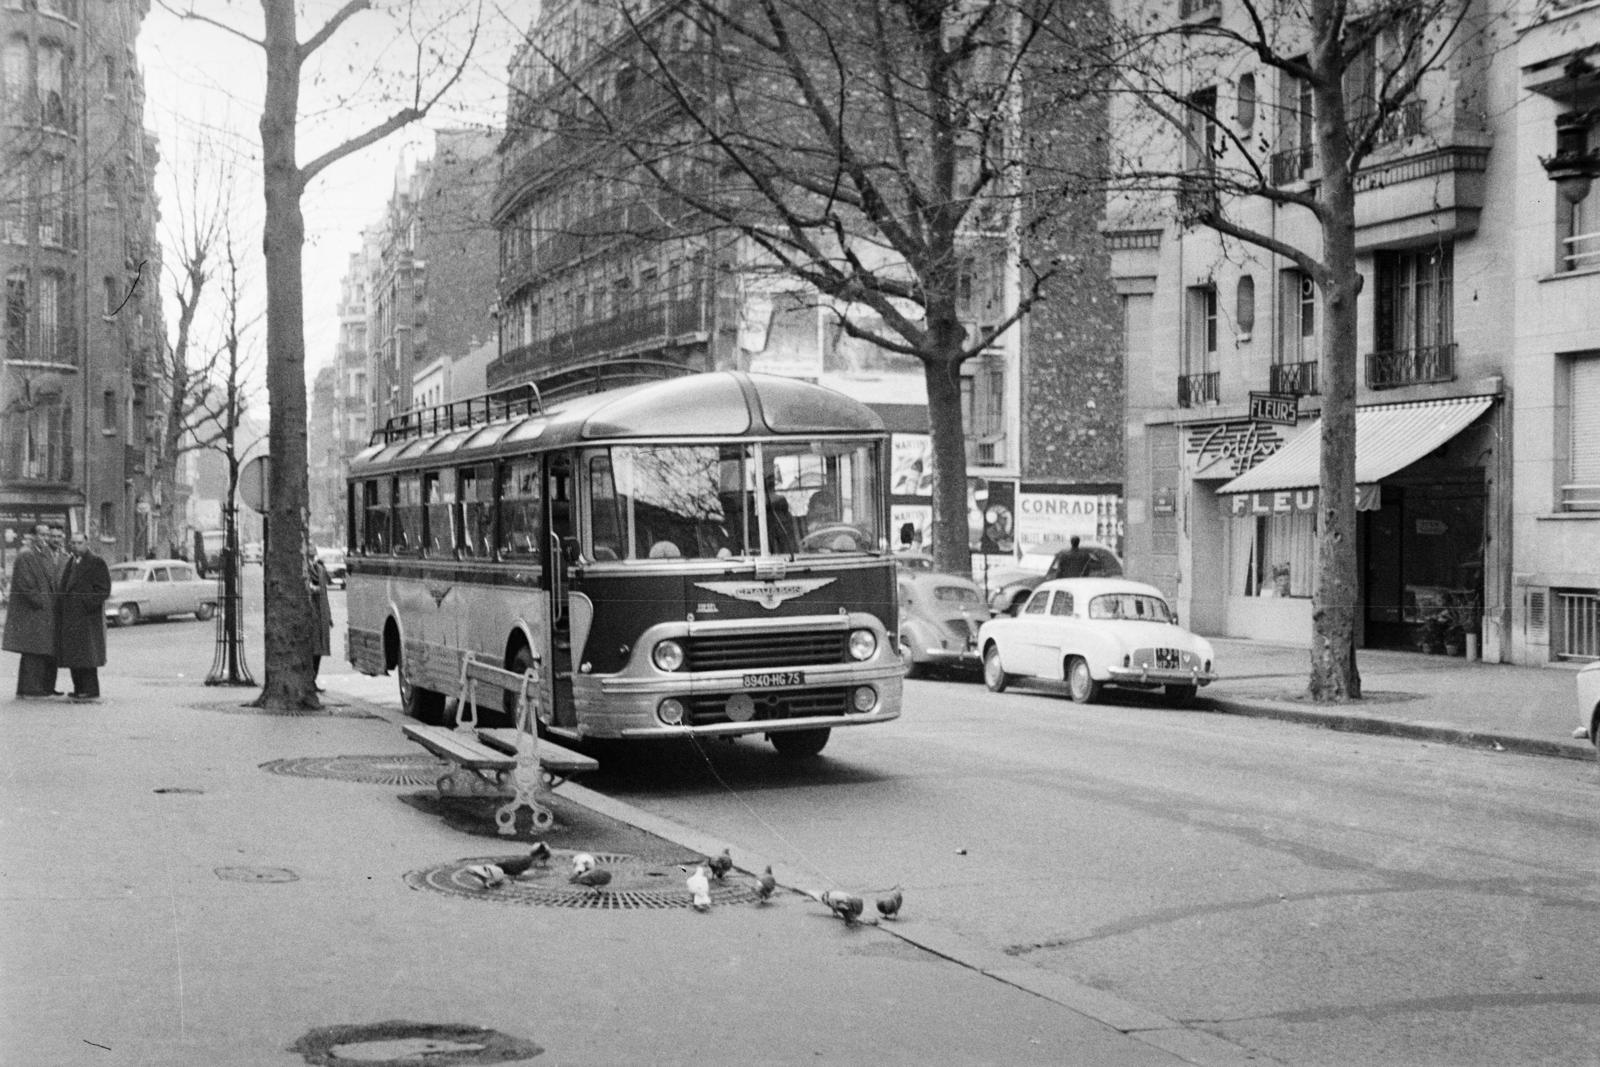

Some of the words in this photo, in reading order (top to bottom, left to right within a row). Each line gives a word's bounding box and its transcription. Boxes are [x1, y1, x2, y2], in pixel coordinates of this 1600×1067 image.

[1251, 400, 1296, 421] FLEURS
[1195, 422, 1277, 473] Coiffu
[1021, 499, 1095, 514] CONRAD
[1232, 487, 1360, 513] FLEU
